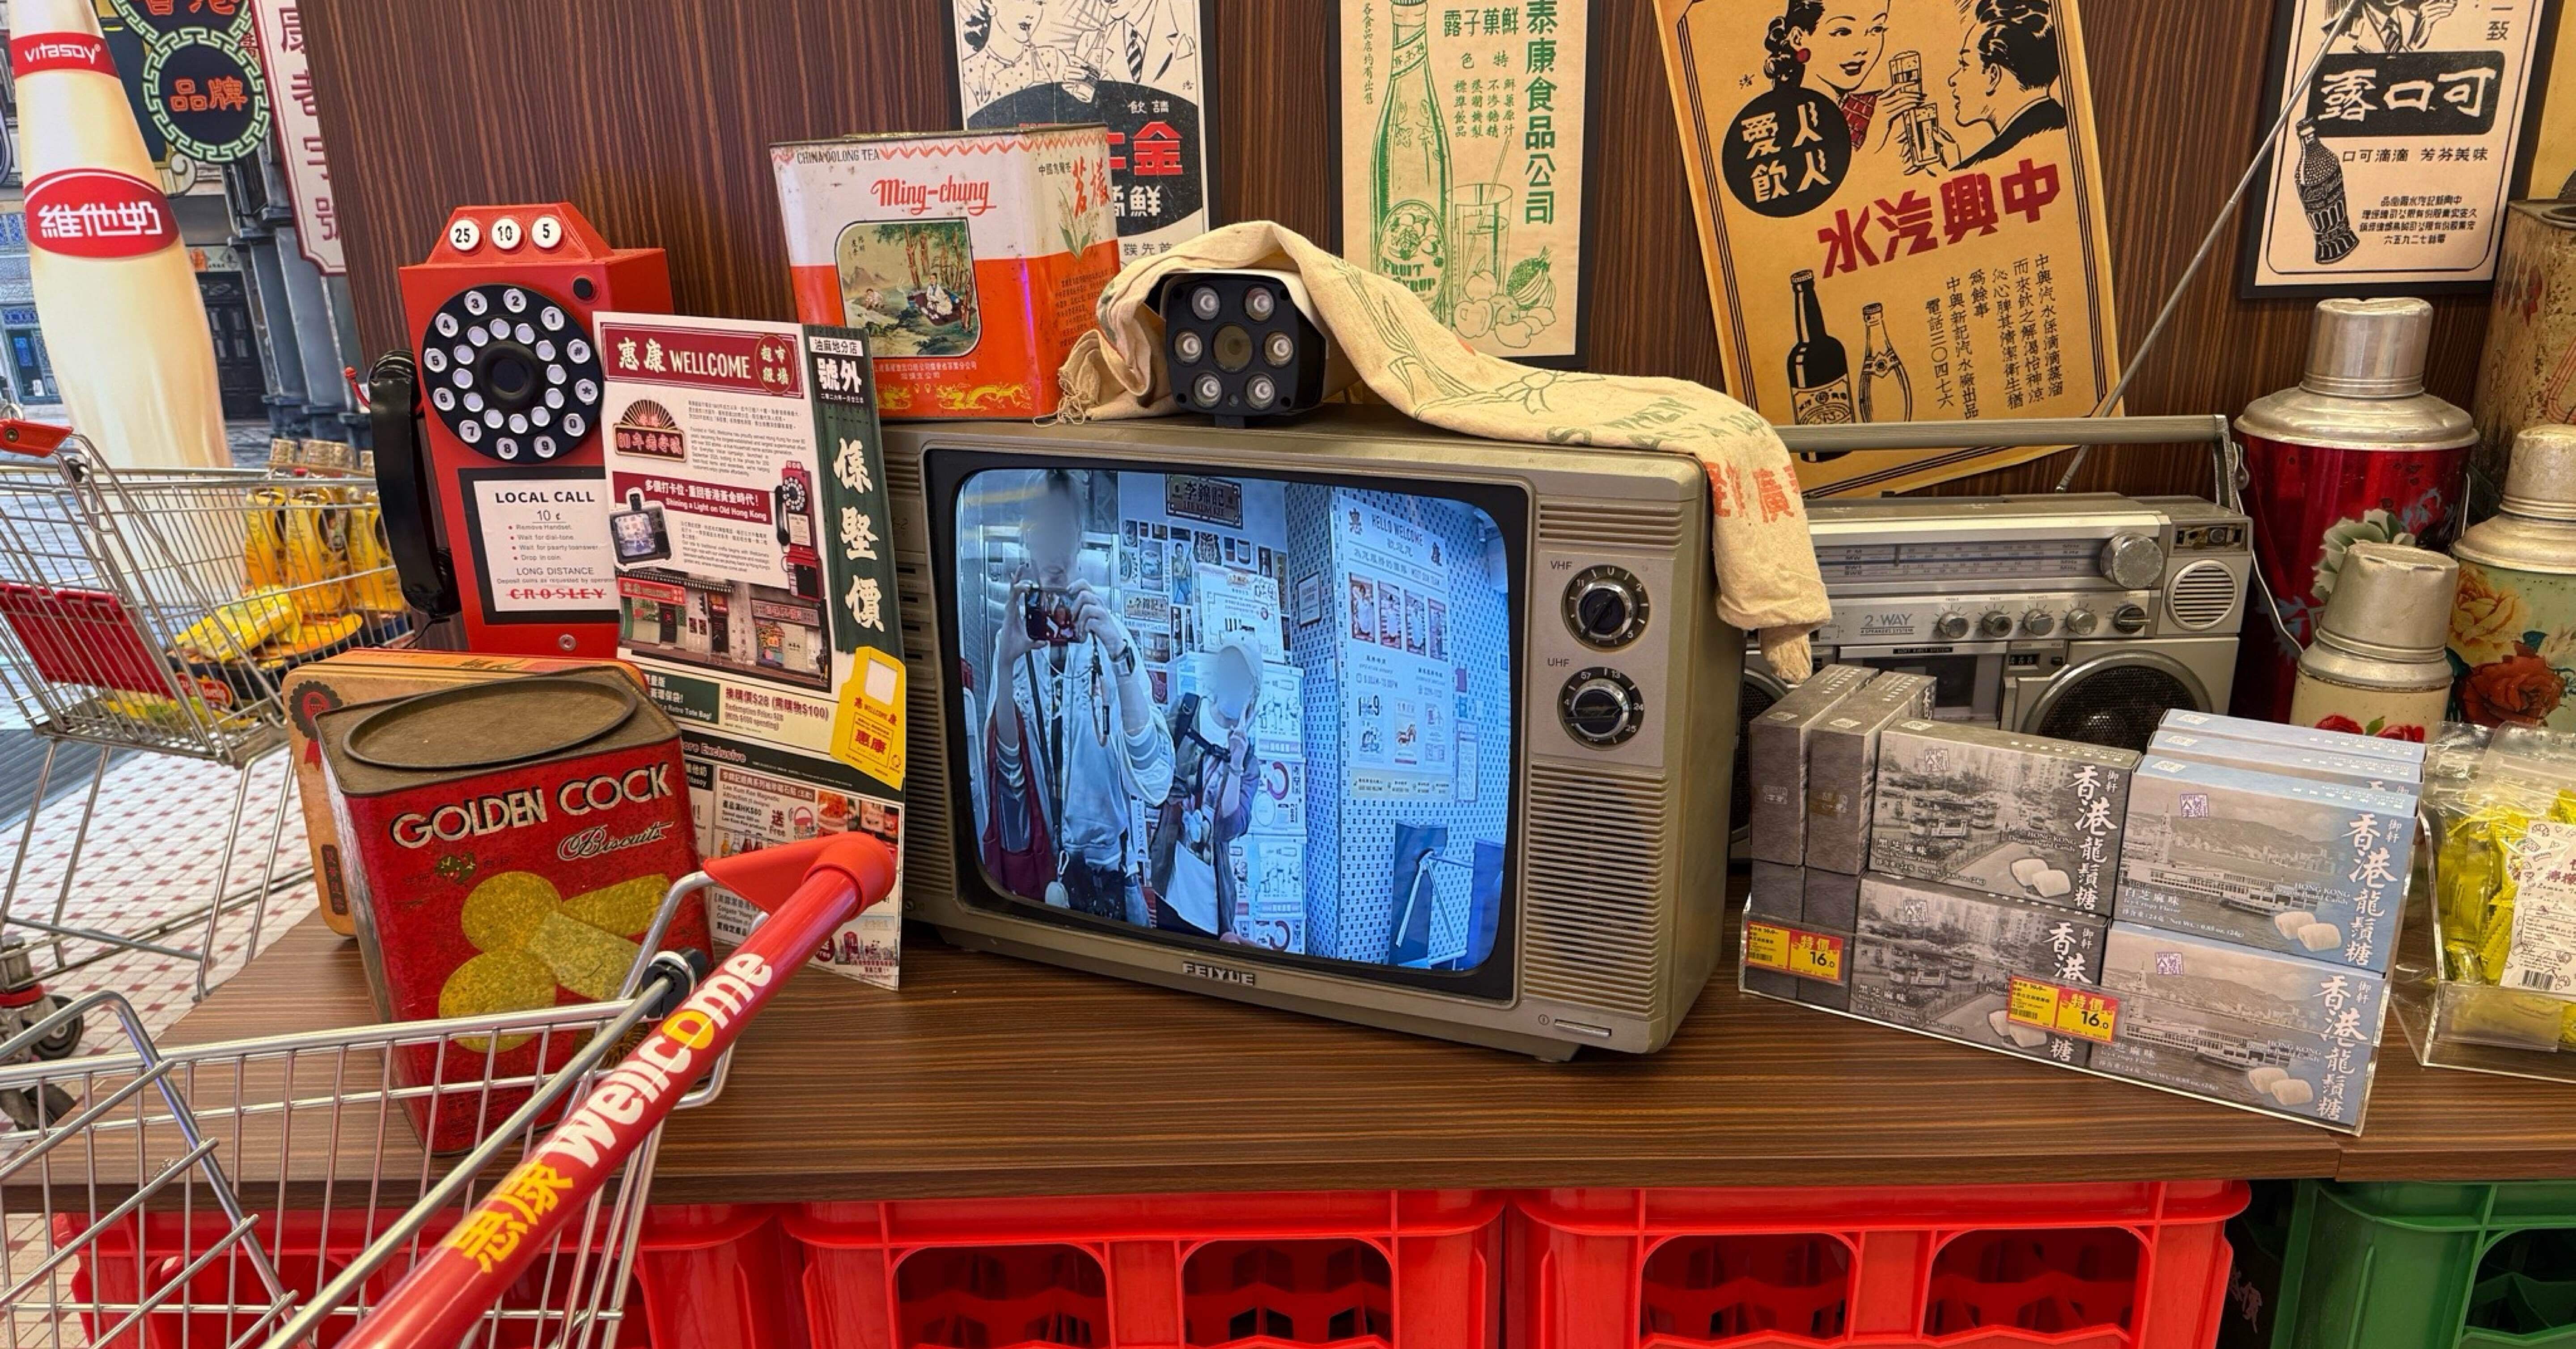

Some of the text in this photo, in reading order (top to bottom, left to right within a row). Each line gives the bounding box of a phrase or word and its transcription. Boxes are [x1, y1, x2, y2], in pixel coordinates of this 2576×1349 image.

[25, 44, 96, 64] vitasoy
[170, 76, 247, 112] 品牌
[2317, 66, 2497, 122] 可口露
[1524, 0, 1558, 225] 泰康食品公司
[1792, 100, 1831, 193] 人人
[797, 150, 823, 165] CHINA
[862, 148, 880, 161] TEA
[1741, 112, 1788, 204] 愛飲
[870, 175, 997, 216] Ming-chung
[38, 201, 162, 238] 維他奶
[1817, 157, 2061, 278] 中興汽水
[455, 223, 550, 243] 25 10 5
[1382, 258, 1425, 276] FRUIT
[472, 298, 479, 309] 3
[512, 296, 520, 306] 2
[443, 320, 450, 330] 4
[550, 313, 555, 323] 1
[432, 355, 439, 365] 5
[617, 337, 752, 379] 惠康 WELLCOME
[817, 357, 862, 393] 號外
[441, 393, 447, 403] 6
[467, 427, 475, 437] 7
[570, 419, 576, 429] 0
[504, 444, 511, 453] 8
[542, 441, 548, 450] 9
[495, 491, 595, 503] LOCAL CALL
[537, 509, 551, 521] 10
[665, 498, 688, 509] Shining
[694, 501, 709, 513] Light
[719, 505, 730, 514] Old
[731, 508, 748, 518] Hong
[749, 510, 767, 521] Kong
[834, 437, 885, 632] 係堅價
[1372, 513, 1423, 547] HELLO WELCOME
[1551, 561, 1572, 570] VHF
[509, 588, 605, 599] CROSLEY
[1635, 584, 1642, 592] 2
[1548, 658, 1570, 666] UHF
[699, 710, 712, 720] Bag!
[855, 729, 886, 755] 惠康
[700, 742, 746, 763] Exclusive
[390, 764, 674, 849] GOLDEN COCK
[771, 810, 784, 827] 送
[769, 825, 786, 837] Free
[557, 821, 674, 861] Biscuits
[2295, 882, 2350, 898] HONG KONG
[1801, 935, 1830, 951] 特價
[1809, 951, 1835, 968] 16.0
[1182, 962, 1255, 986] FEIYUE
[2071, 993, 2104, 1011] 特價
[2081, 1011, 2109, 1029] 16.0
[538, 953, 773, 1168] wellcome
[452, 1160, 573, 1273] 惠康
